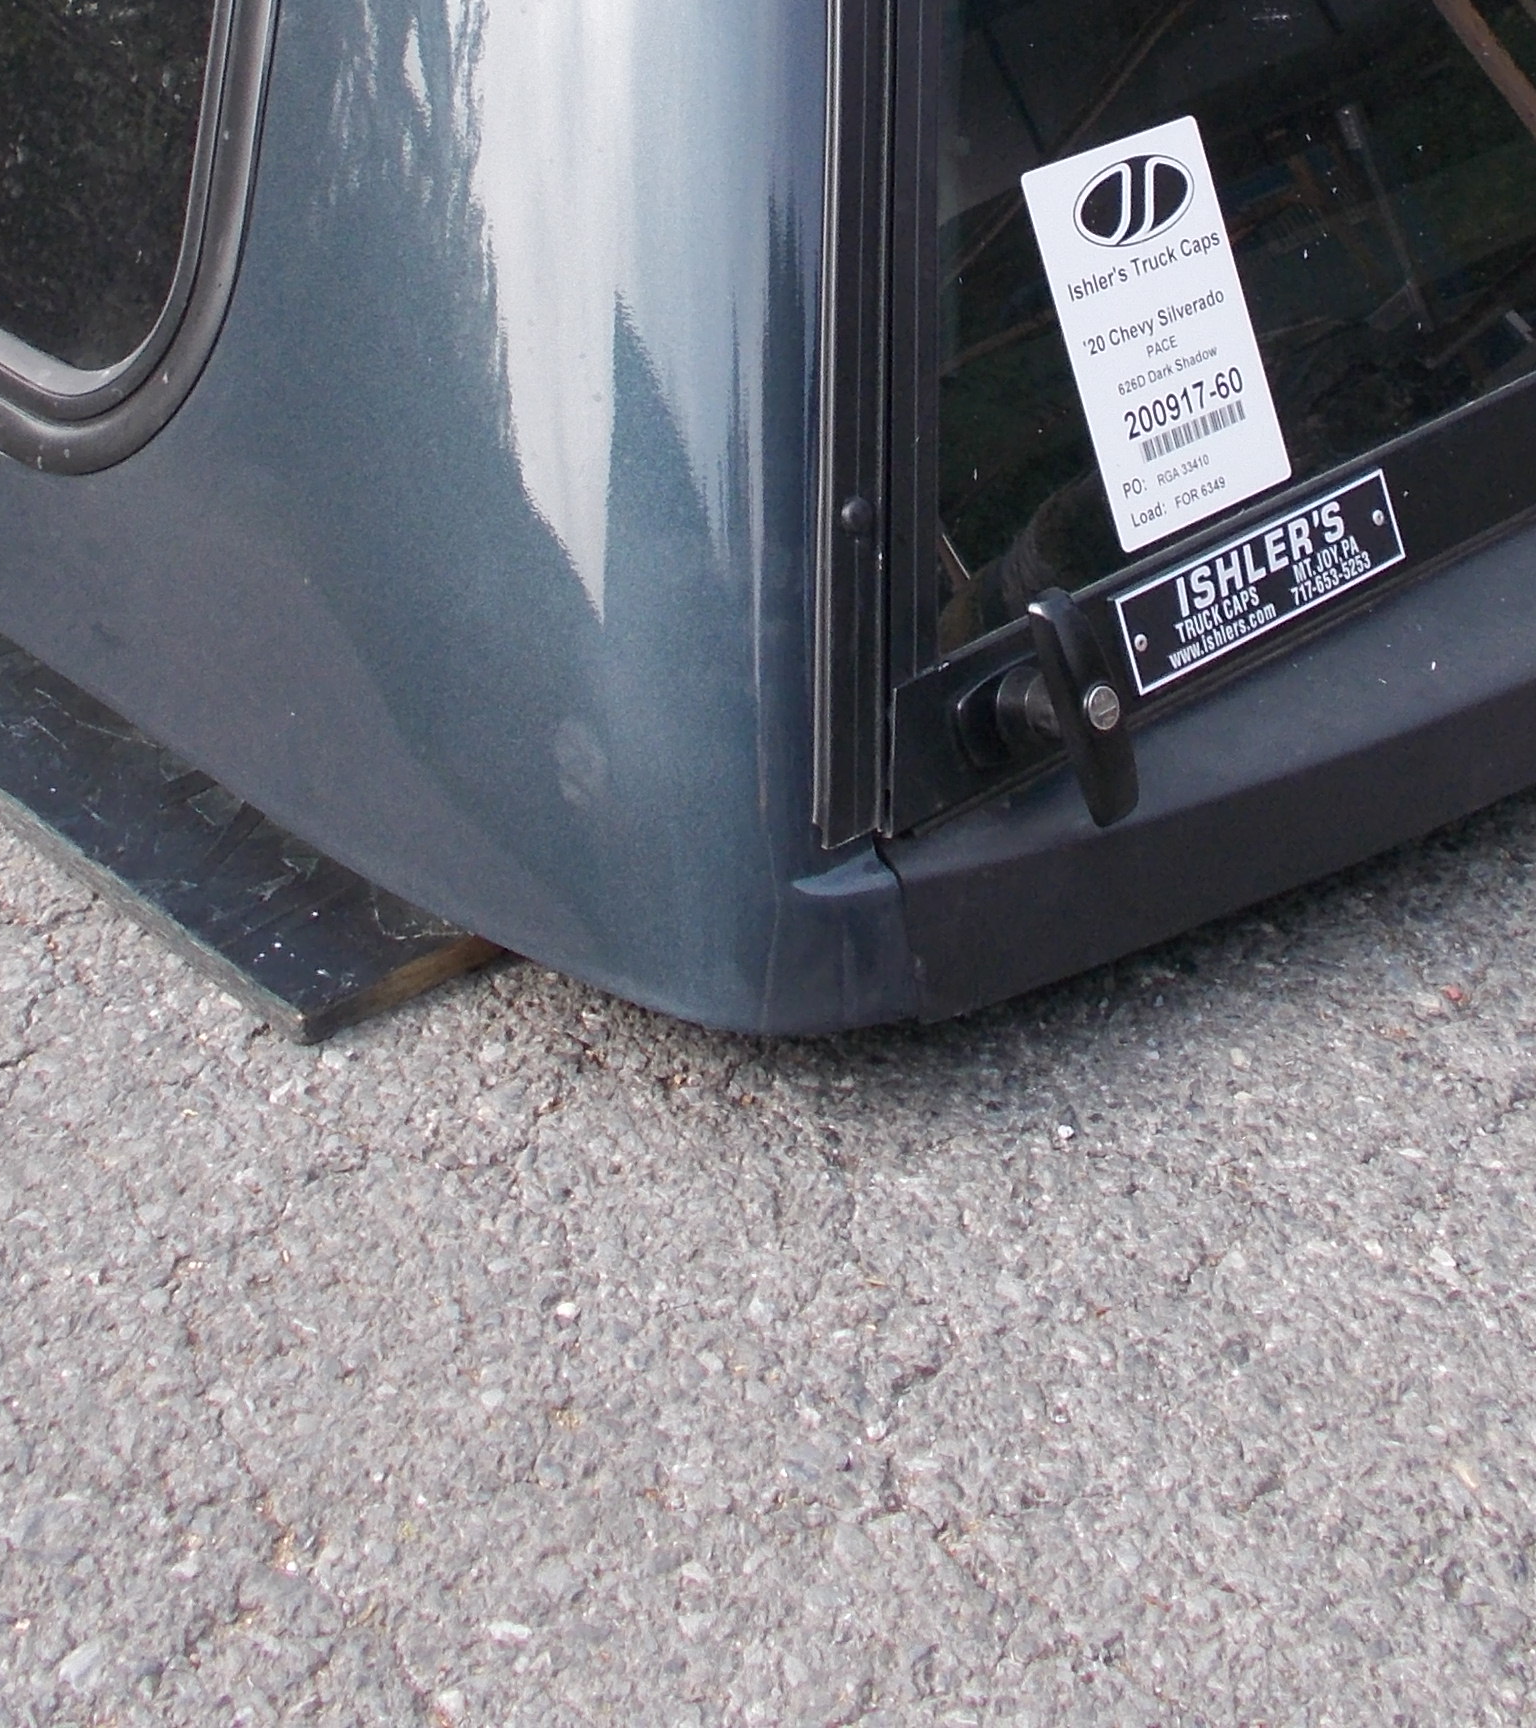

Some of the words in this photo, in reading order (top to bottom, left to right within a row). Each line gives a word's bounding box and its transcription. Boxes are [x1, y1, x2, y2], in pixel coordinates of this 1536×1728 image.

[1067, 267, 1128, 302] Ishler's
[1130, 245, 1178, 276] Truck
[1180, 232, 1221, 257] Caps
[1083, 334, 1106, 356] '20
[1109, 318, 1154, 346] Chevy
[1157, 289, 1225, 326] Silverado
[1146, 335, 1178, 358] PACE
[1117, 375, 1146, 396] 626D
[1149, 363, 1174, 383] Dark
[1174, 347, 1218, 372] Shadow
[1124, 367, 1243, 440] 200917-60
[1122, 478, 1147, 499] PO:
[1157, 467, 1180, 486] RGA
[1181, 453, 1210, 475] 33410
[1131, 501, 1167, 528] Load:
[1174, 488, 1200, 509] FOR
[1201, 476, 1226, 497] 6349
[1176, 501, 1345, 618] ISHLER'S
[1290, 551, 1371, 606] 717-653-5253
[1168, 602, 1277, 670] www.ishlers.com
[1174, 607, 1224, 643] TRUCK
[1223, 586, 1260, 620] CAPS
